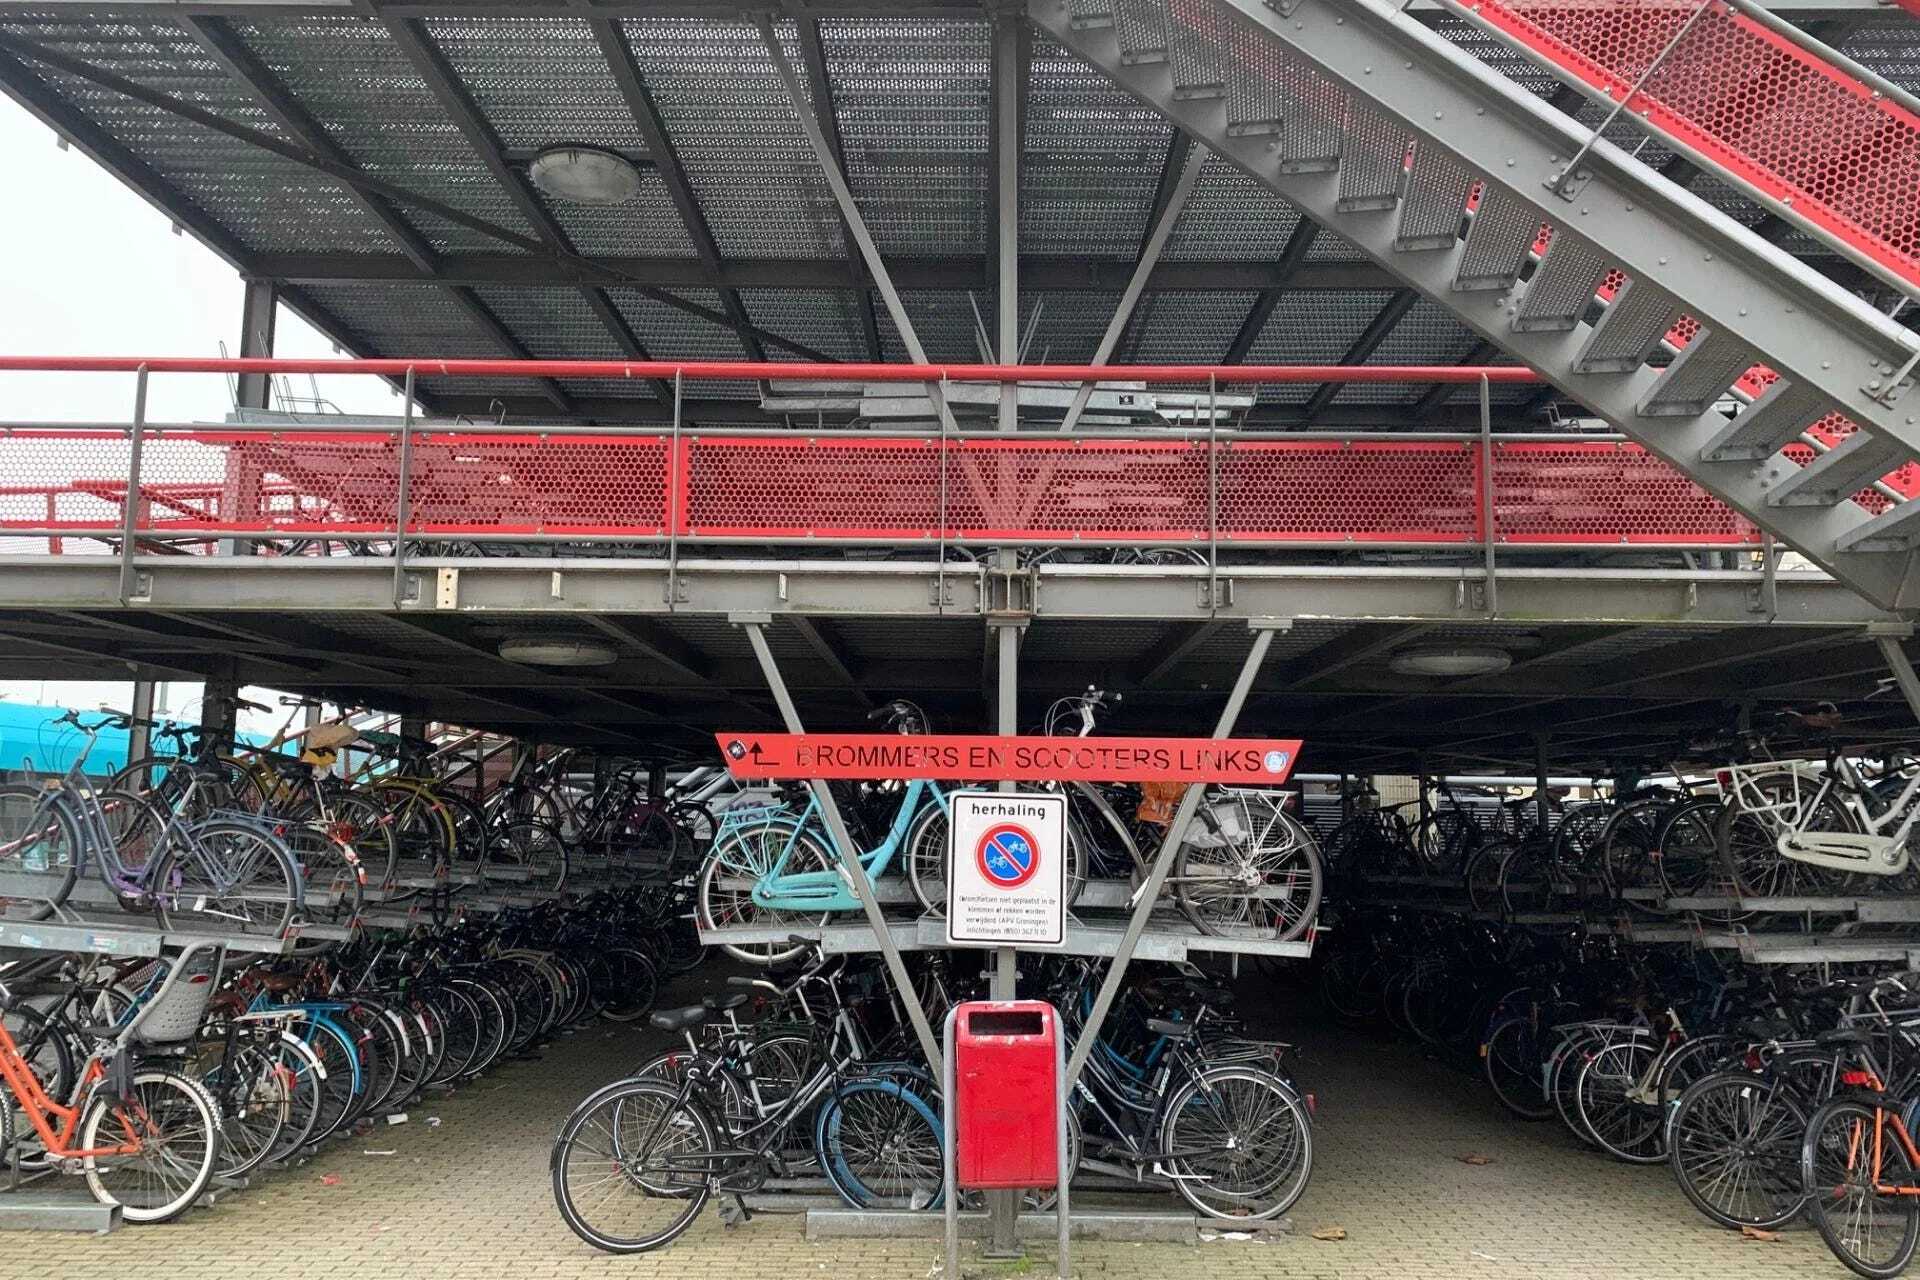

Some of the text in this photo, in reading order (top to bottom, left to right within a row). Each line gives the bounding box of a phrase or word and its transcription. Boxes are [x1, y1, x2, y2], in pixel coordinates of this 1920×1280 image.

[796, 745, 1262, 772] BROMMERS EN SCOOTERS LINKS
[971, 803, 1046, 820] herhaling
[999, 896, 1012, 904] niet
[1041, 897, 1048, 905] in
